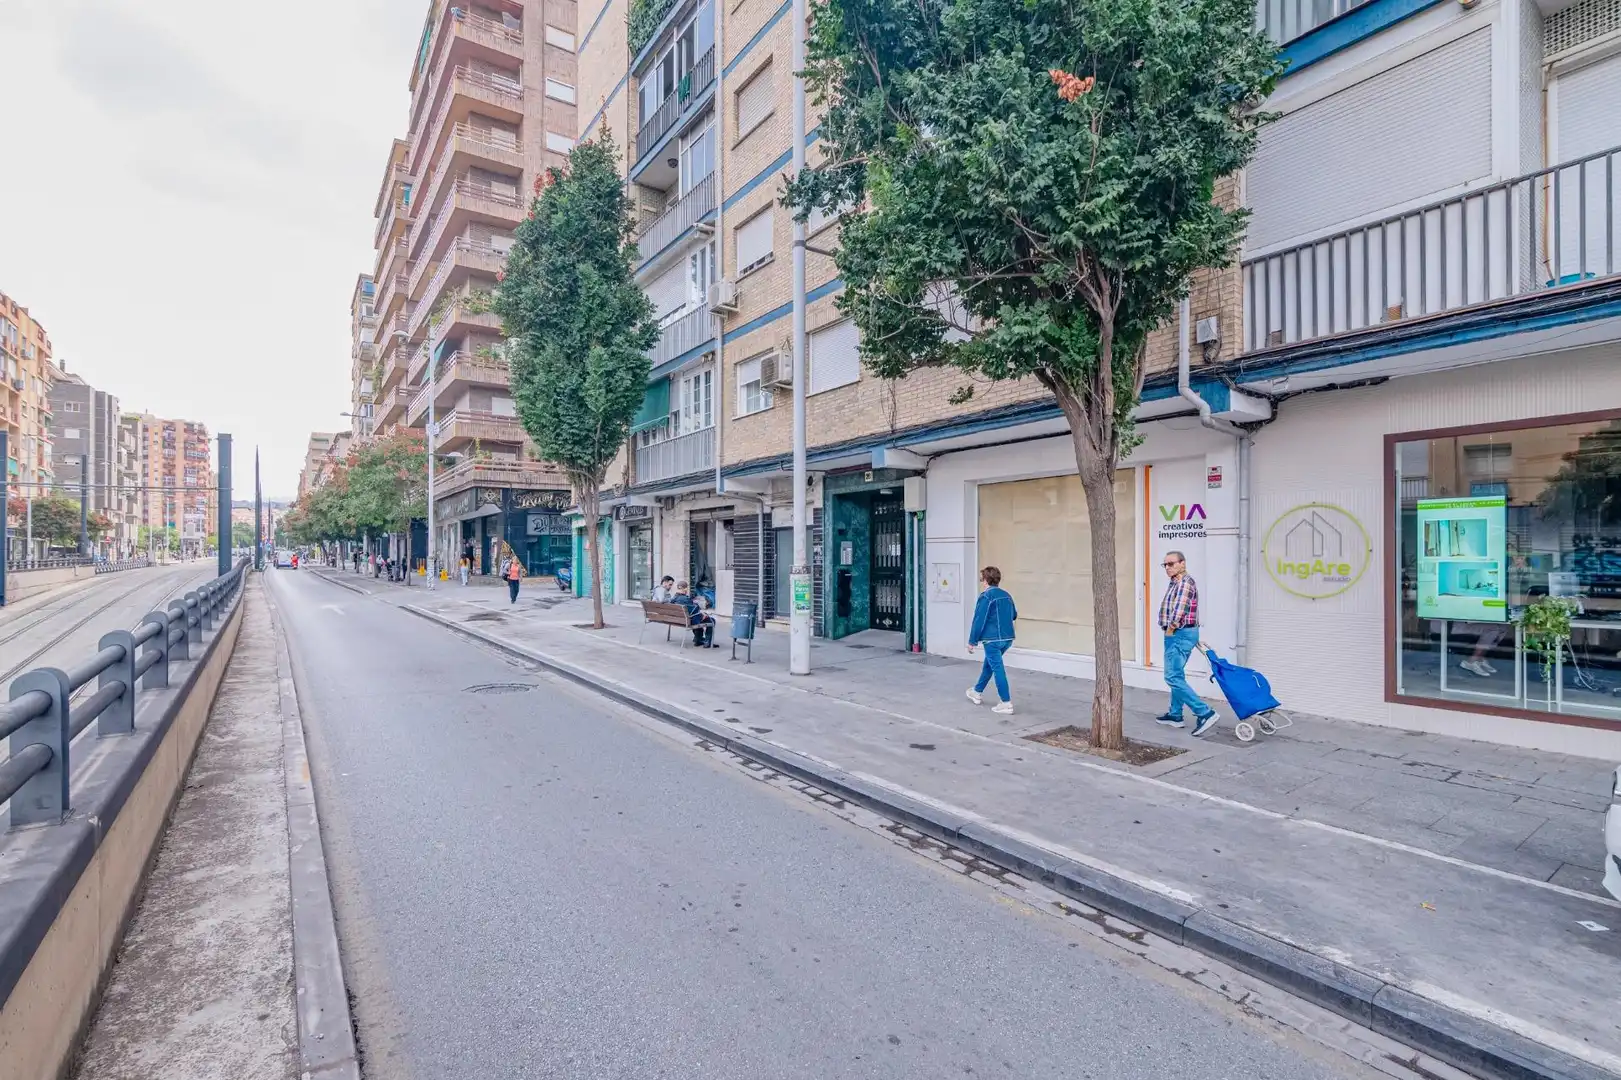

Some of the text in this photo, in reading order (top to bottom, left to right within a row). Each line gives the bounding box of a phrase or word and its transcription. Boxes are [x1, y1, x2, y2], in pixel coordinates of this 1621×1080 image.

[1159, 504, 1206, 521] VIA
[1163, 522, 1203, 531] creativos
[1158, 531, 1207, 540] impresores
[1277, 559, 1351, 579] IngAre
